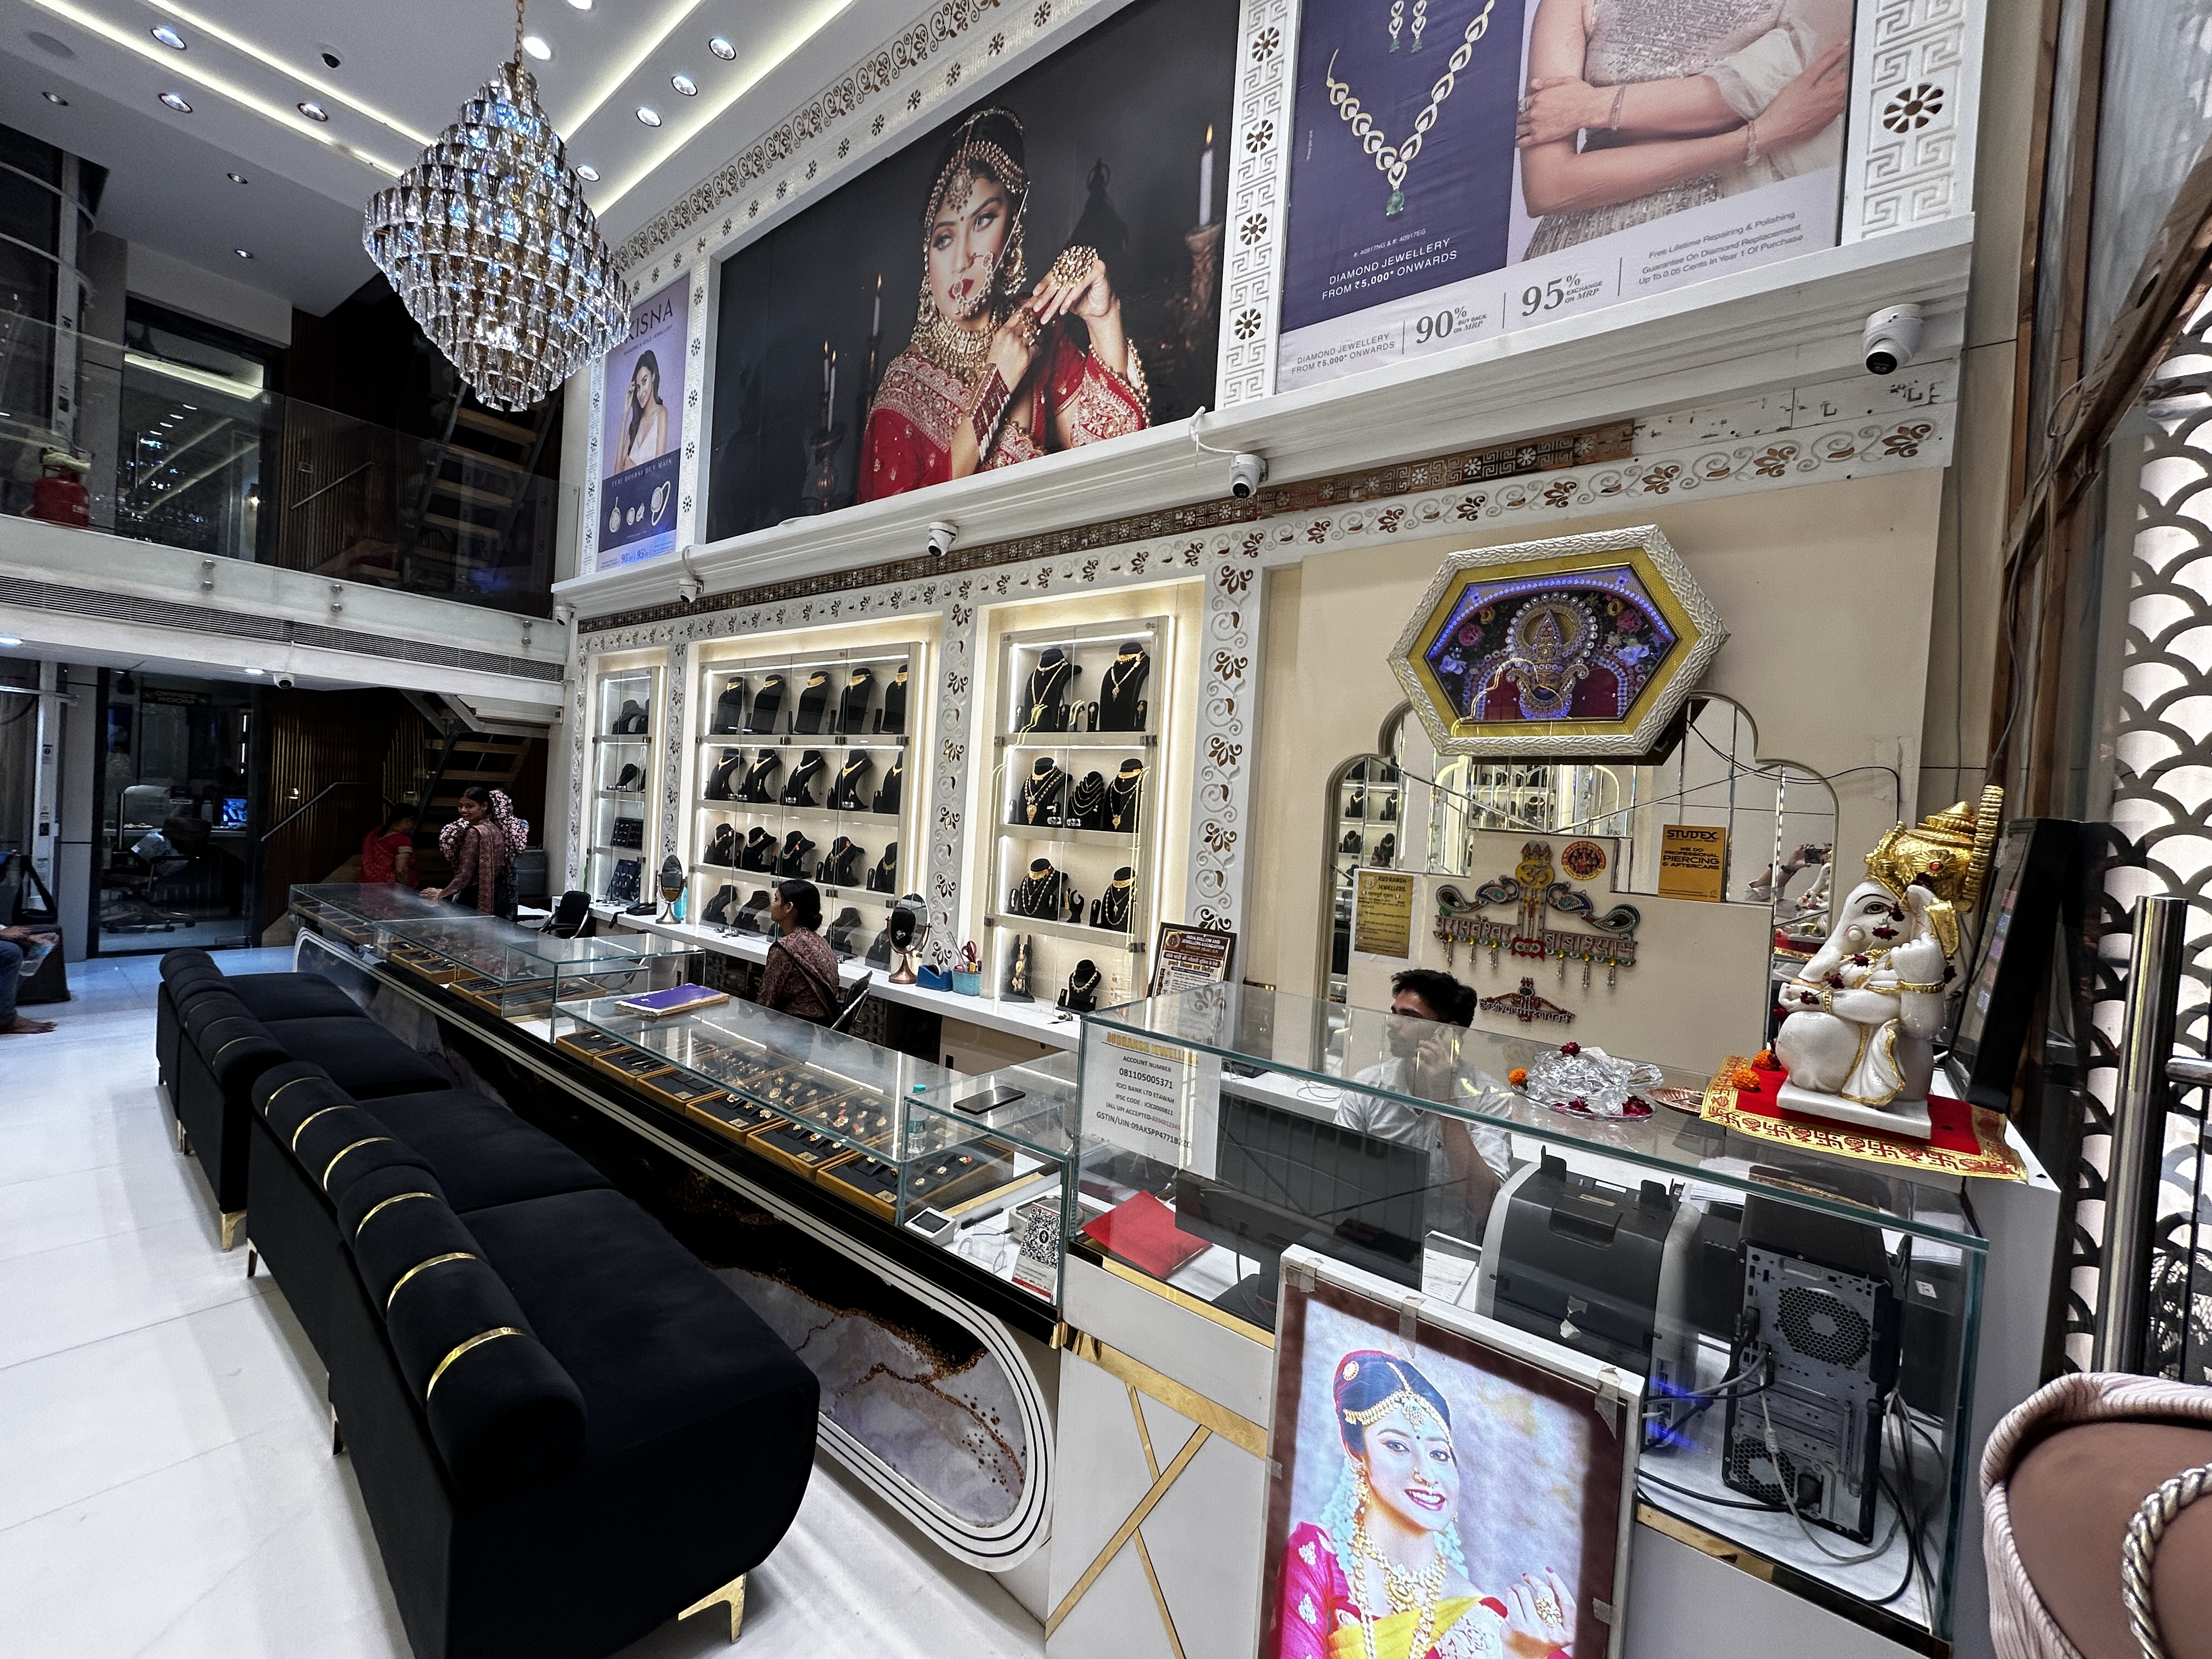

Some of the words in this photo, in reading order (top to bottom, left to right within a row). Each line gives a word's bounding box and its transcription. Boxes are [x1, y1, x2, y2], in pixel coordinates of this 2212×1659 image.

[1649, 249, 1667, 258] Free
[1748, 245, 1758, 254] Of
[1329, 262, 1378, 285] DIAMOND
[1381, 238, 1451, 268] JEWELLERY
[1322, 284, 1352, 301] FROM
[1397, 250, 1457, 276] ONWARDS
[1567, 281, 1602, 295] EXCHANGE
[1577, 287, 1599, 300] MRP
[1471, 314, 1487, 323] BACK
[1465, 320, 1483, 331] MRP
[1297, 348, 1335, 364] DIAMOND
[1338, 332, 1389, 353] JEWELLERY
[1291, 363, 1314, 374] FROM
[1350, 341, 1395, 359] ONWARDS
[1667, 830, 1718, 839] STUDEX
[1663, 855, 1719, 865] PIERCING
[1122, 1056, 1148, 1066] ACCOUNT
[1149, 1062, 1171, 1073] NUMBER
[1119, 1068, 1173, 1090] 081105005371
[1115, 1093, 1126, 1102] IFSC
[1127, 1097, 1141, 1105] CODE
[1128, 1085, 1142, 1094] BANK
[1153, 1091, 1174, 1104] ETAWAH
